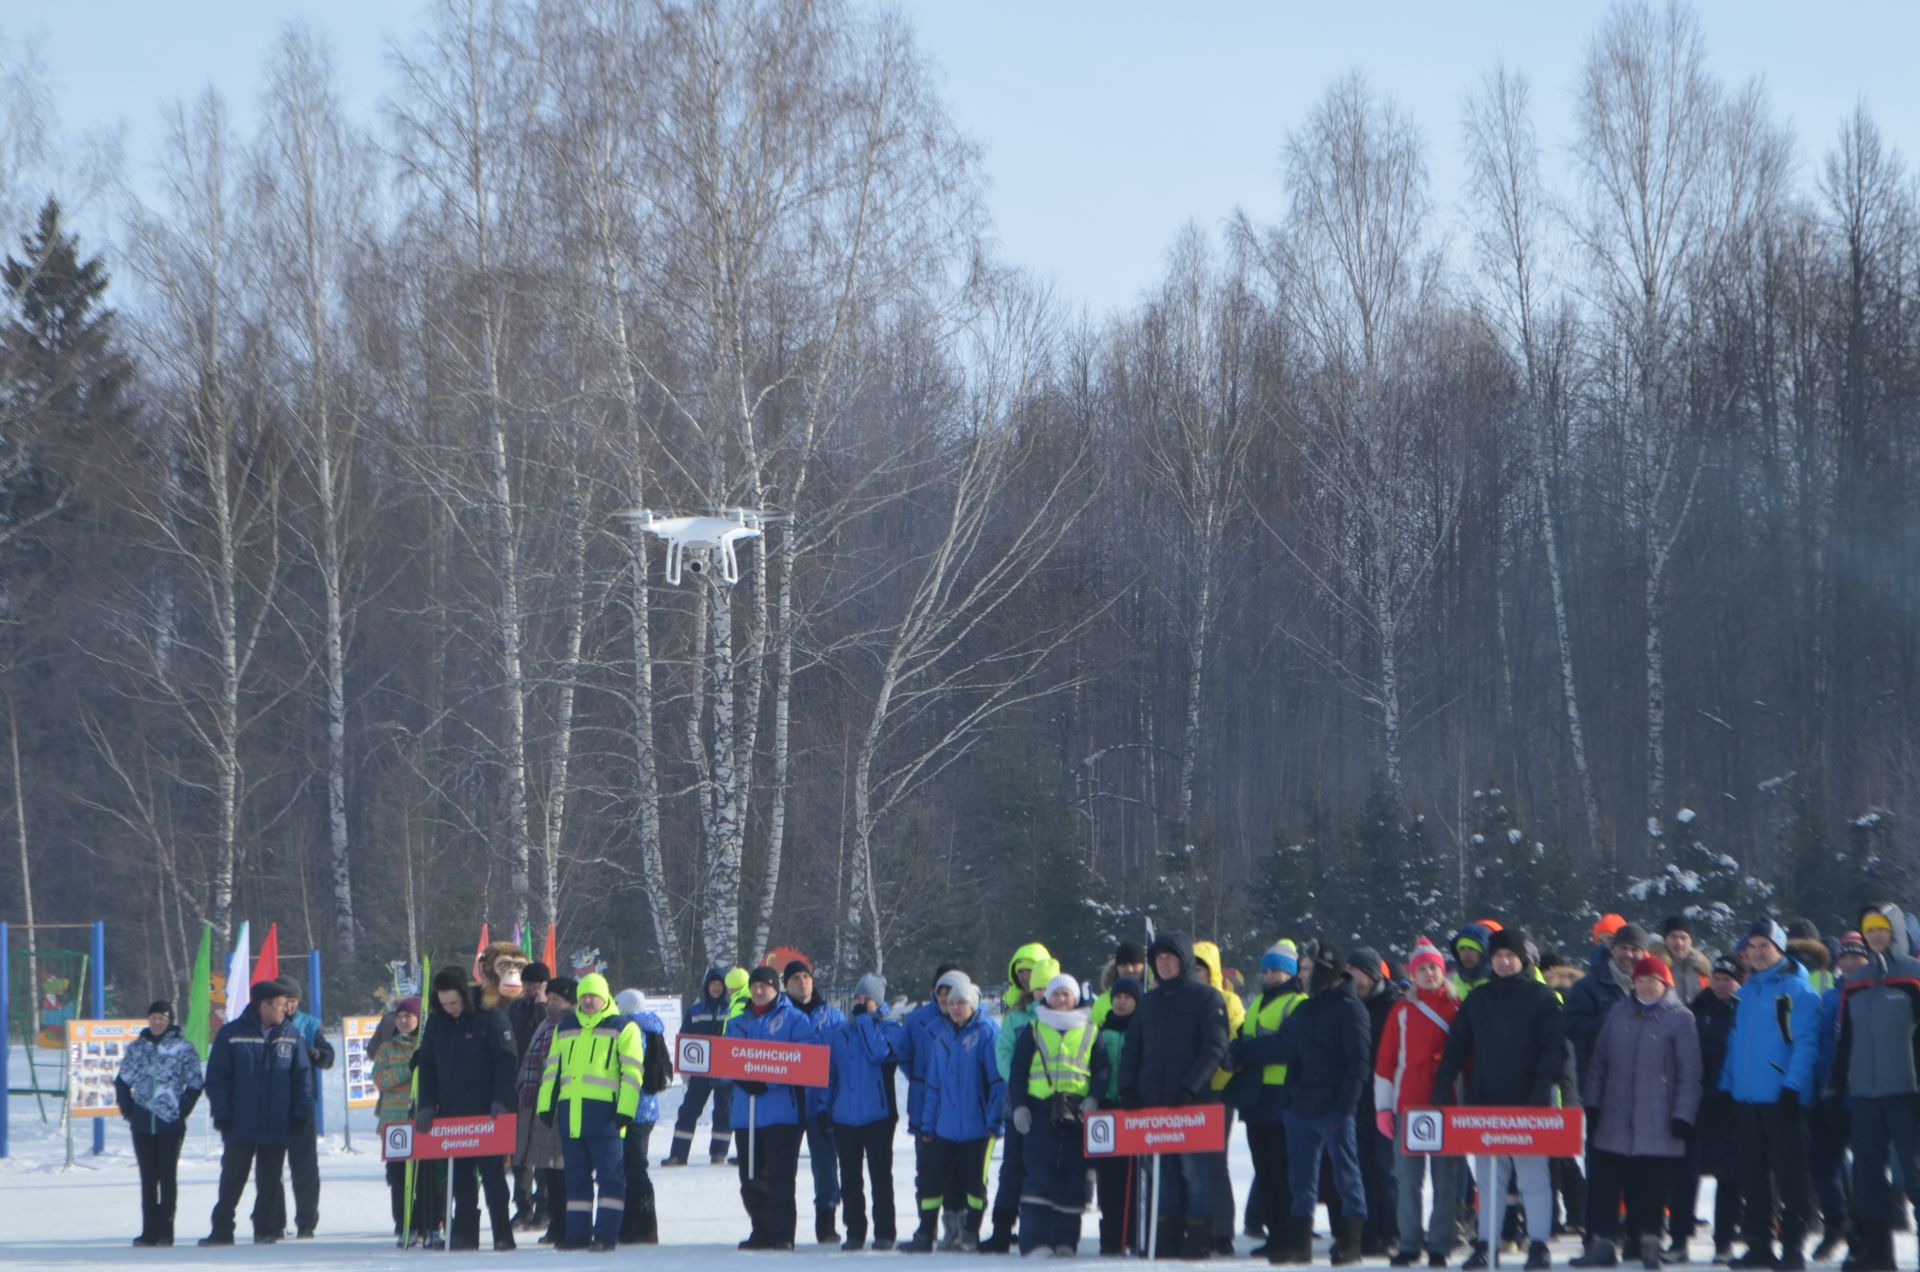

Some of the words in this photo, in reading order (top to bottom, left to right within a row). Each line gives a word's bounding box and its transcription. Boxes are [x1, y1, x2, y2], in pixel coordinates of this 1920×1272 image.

[731, 1046, 801, 1062] САБИНСКИЙ
[744, 1062, 787, 1075] филиал
[1124, 1111, 1206, 1130] ПРИГОРОДНЫЙ
[1451, 1113, 1564, 1130] НИЖНЕКАМСКИЙ
[441, 1138, 479, 1151] филиал
[1144, 1132, 1185, 1146] филиал
[1481, 1131, 1533, 1146] филиал
